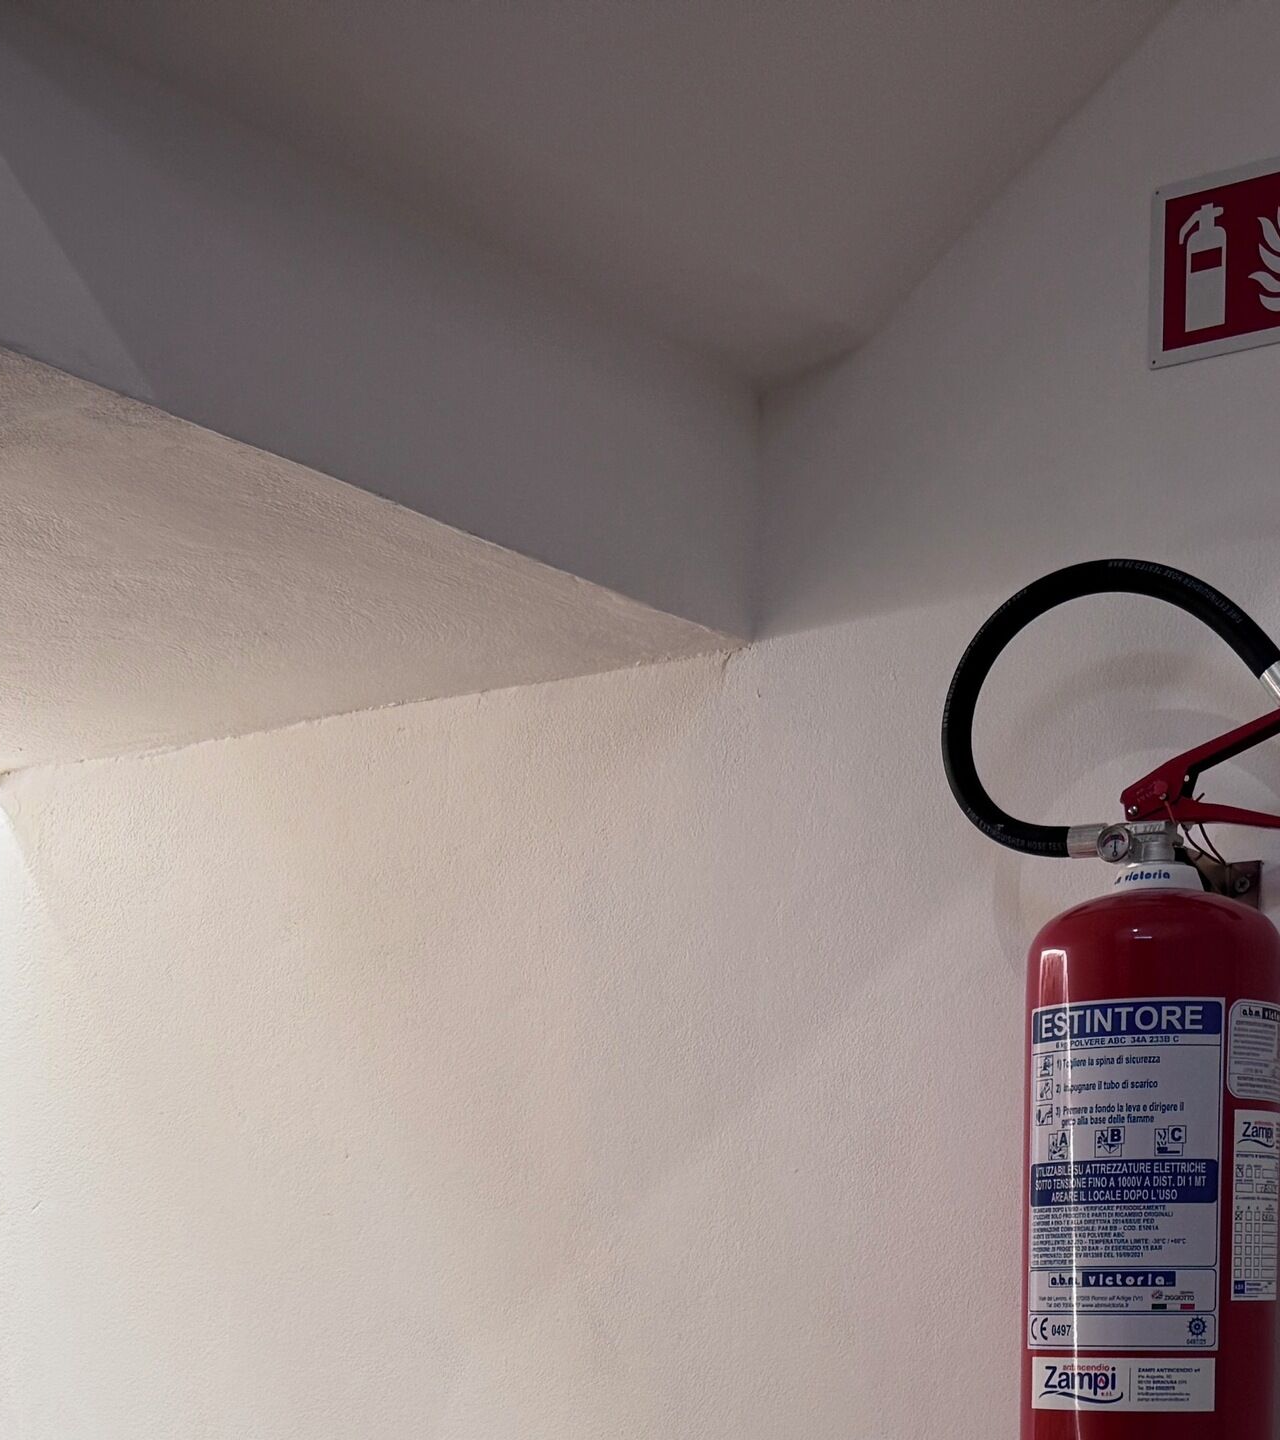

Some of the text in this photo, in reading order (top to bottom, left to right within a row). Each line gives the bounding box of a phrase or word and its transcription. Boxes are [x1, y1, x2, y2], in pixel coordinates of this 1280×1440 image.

[1041, 1005, 1203, 1039] ESTINTORE
[1070, 1037, 1106, 1048] POLVERE
[1108, 1036, 1126, 1045] ABC
[1173, 1035, 1180, 1043] C
[1088, 1056, 1094, 1066] la
[1096, 1055, 1115, 1068] spina
[1116, 1054, 1124, 1065] di
[1125, 1054, 1161, 1065] sicurezza
[1097, 1081, 1103, 1091] il
[1104, 1080, 1120, 1090] tubo
[1122, 1080, 1129, 1089] di
[1130, 1079, 1159, 1089] scarico
[1089, 1106, 1094, 1114] a
[1095, 1103, 1115, 1113] fondo
[1117, 1103, 1124, 1113] la
[1125, 1102, 1140, 1112] leva
[1148, 1101, 1178, 1113] dirigere
[1179, 1102, 1185, 1111] il
[1077, 1116, 1089, 1126] alla
[1090, 1115, 1106, 1125] base
[1107, 1114, 1125, 1124] delle
[1126, 1113, 1154, 1124] fiamme
[1059, 1131, 1068, 1146] A
[1110, 1128, 1122, 1142] B
[1170, 1127, 1183, 1142] C
[1073, 1163, 1084, 1175] SU
[1085, 1162, 1151, 1175] ATTREZZATURE
[1153, 1161, 1207, 1174] ELETTRICHE
[1088, 1177, 1107, 1188] FINO
[1108, 1176, 1116, 1188] A
[1117, 1176, 1143, 1188] 1000V
[1144, 1176, 1152, 1187] A
[1153, 1175, 1175, 1187] DIST.
[1177, 1175, 1186, 1187] DI
[1195, 1175, 1207, 1187] MT
[1051, 1189, 1178, 1203] AREARE IL LOCALE DOPO L'USO
[1088, 1273, 1165, 1286] victoria
[1052, 1324, 1072, 1337] 0497
[1044, 1366, 1116, 1396] Zampi
